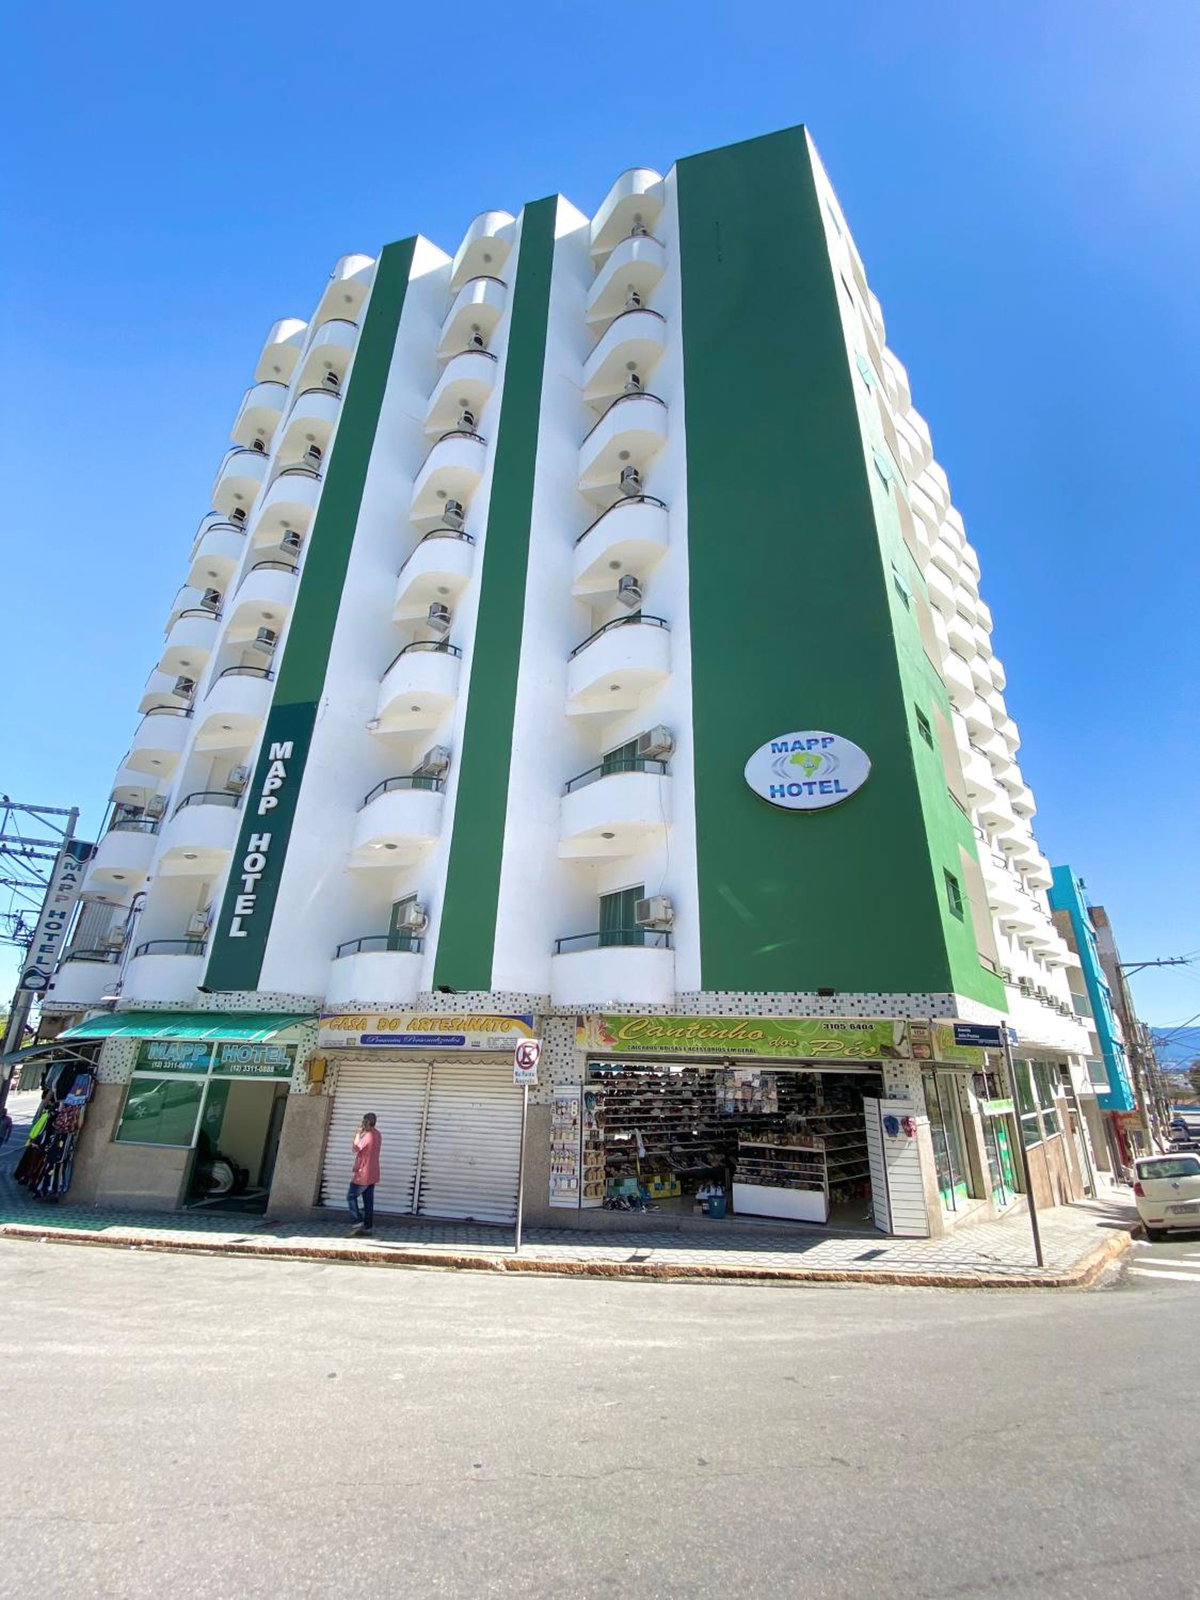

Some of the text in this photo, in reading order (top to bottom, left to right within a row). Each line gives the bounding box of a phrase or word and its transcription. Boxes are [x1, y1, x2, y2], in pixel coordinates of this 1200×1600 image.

[771, 736, 835, 754] MAPP
[769, 779, 848, 799] HOTEL
[229, 740, 295, 938] MAPP HOTEL
[54, 862, 83, 903] MAPP
[36, 909, 67, 965] HOTEL
[329, 1016, 512, 1033] CASA DO ARTESANATO
[618, 1016, 880, 1057] Cantinho dos Pés
[147, 1042, 291, 1066] MAPP HOTEL
